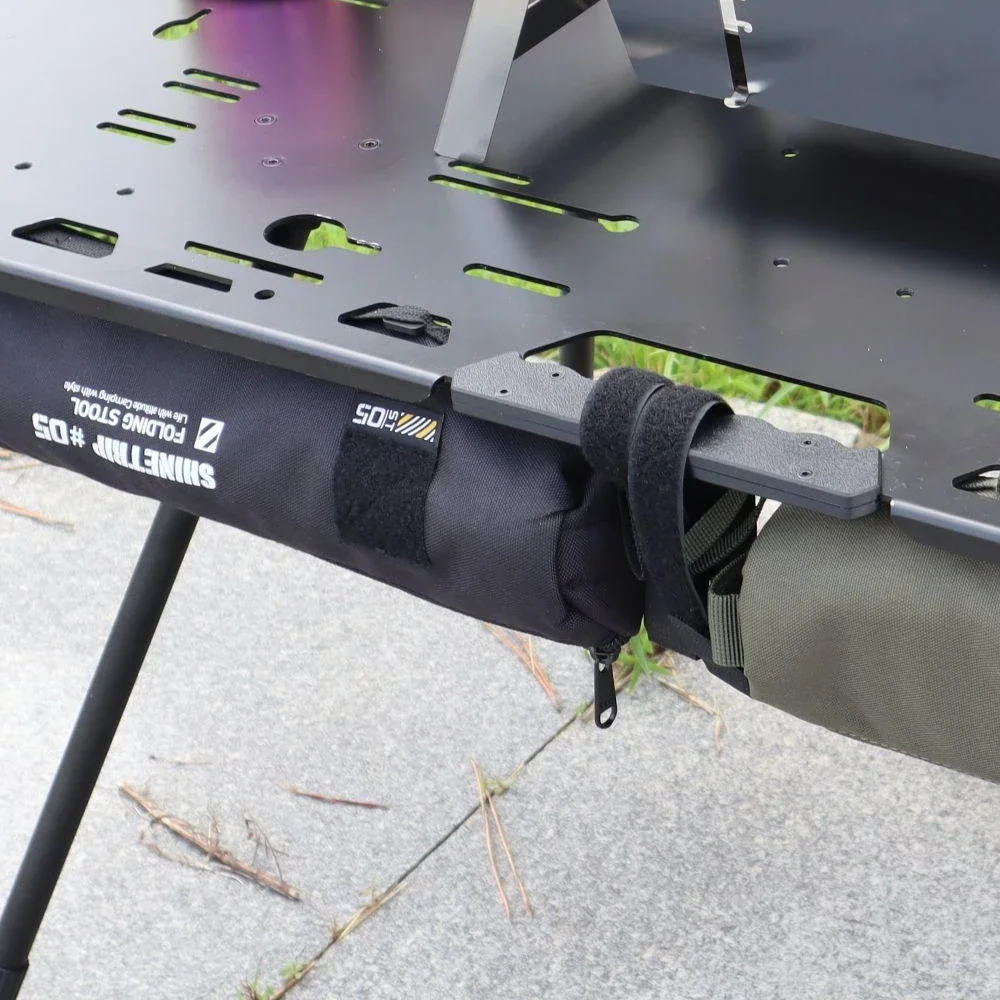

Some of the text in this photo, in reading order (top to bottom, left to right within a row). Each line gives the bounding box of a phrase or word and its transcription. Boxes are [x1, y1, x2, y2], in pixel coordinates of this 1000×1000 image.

[63, 381, 188, 424] Life with attitude Camping with style
[71, 396, 186, 444] FOLDING STOOL
[92, 434, 216, 489] SHINETRIP
